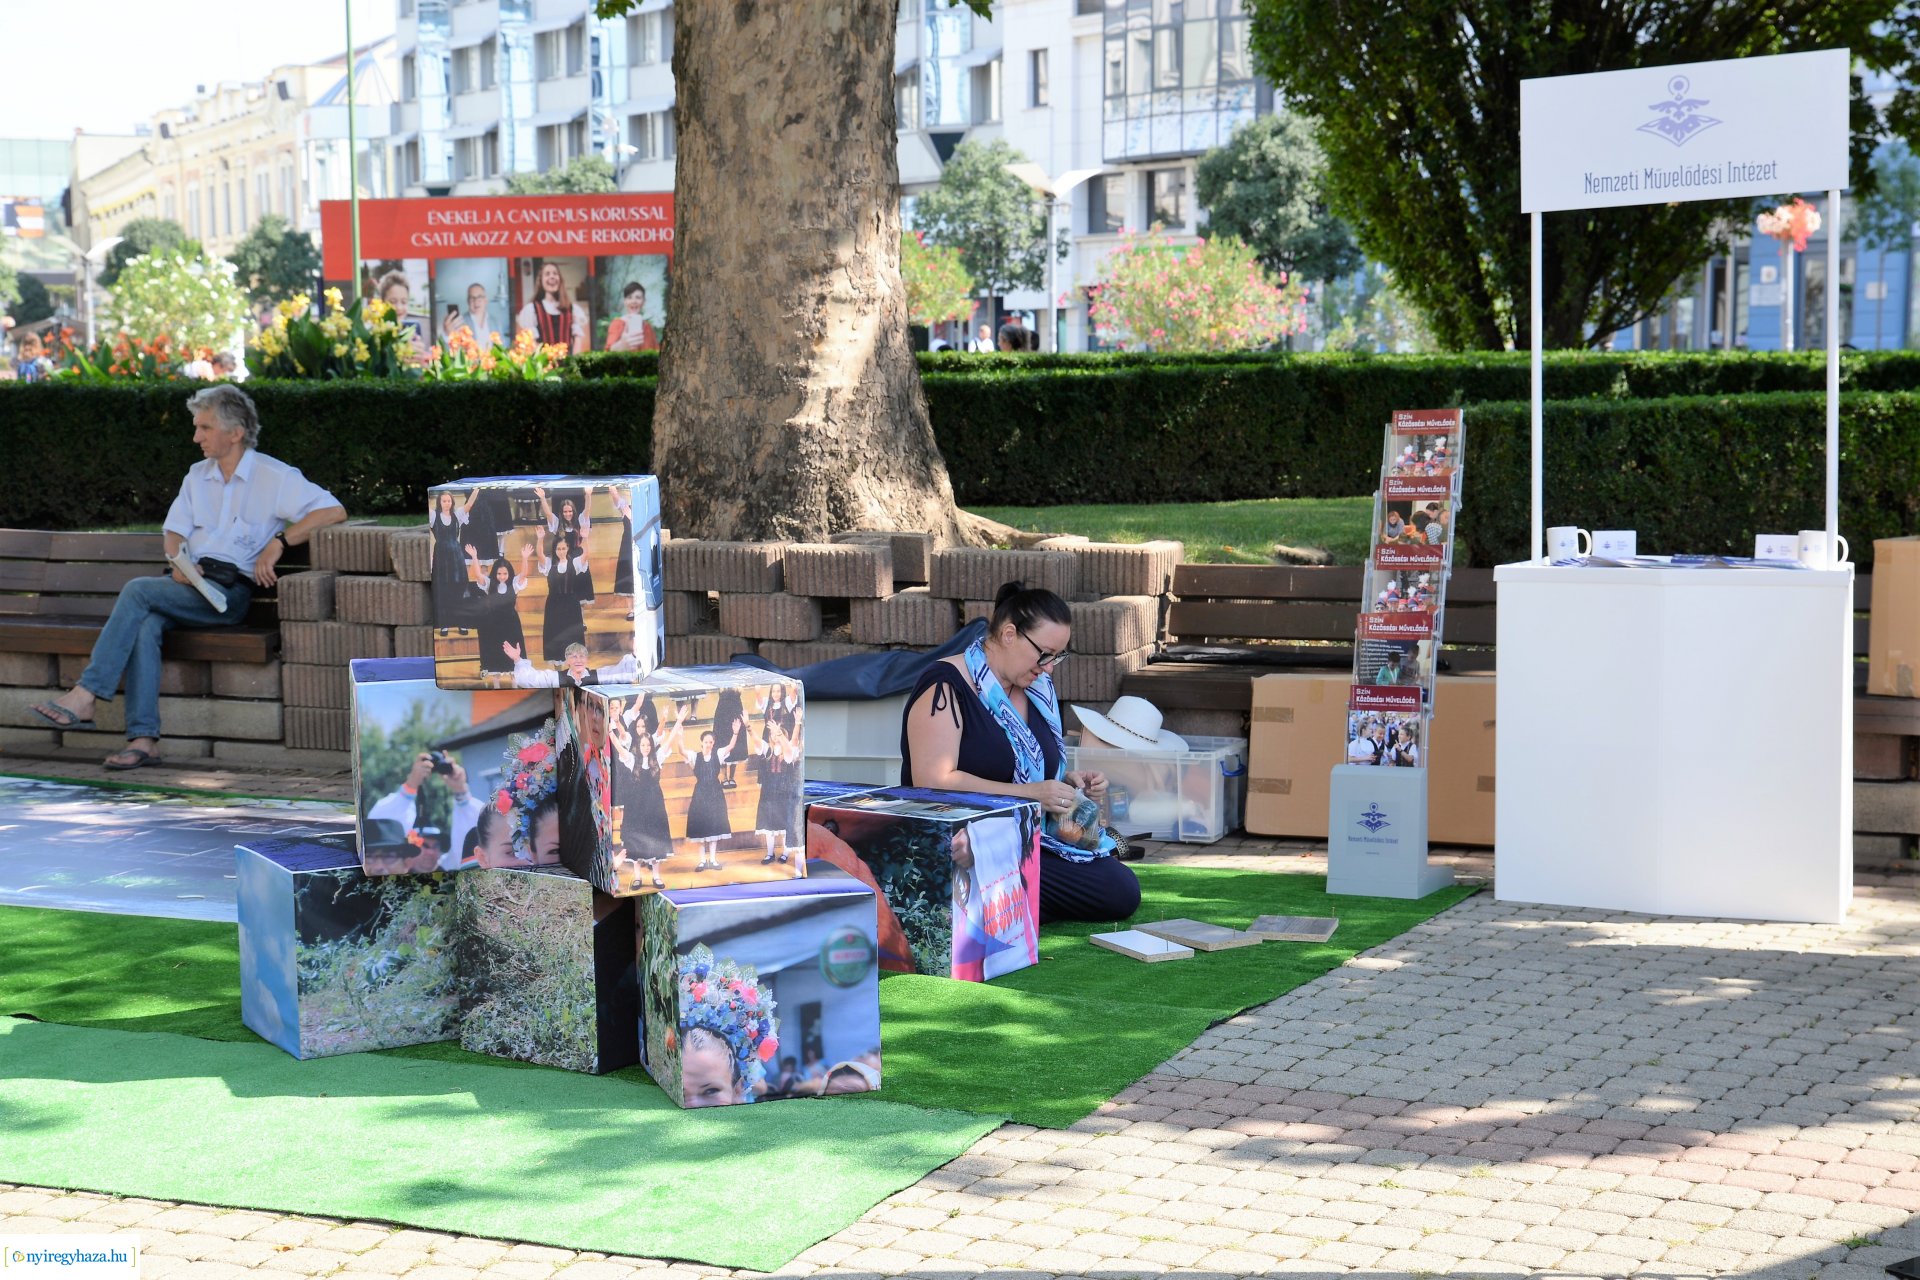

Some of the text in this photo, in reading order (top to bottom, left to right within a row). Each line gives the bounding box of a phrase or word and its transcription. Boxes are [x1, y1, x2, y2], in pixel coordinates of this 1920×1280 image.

[1584, 160, 1778, 194] Nemzeti Művelődési Intézet
[427, 205, 668, 225] ÉNEKELJ A CANTEMUS KÓRUSSAL
[411, 227, 674, 247] CSATLAKOZZ AZ ONLINE REKORDHO
